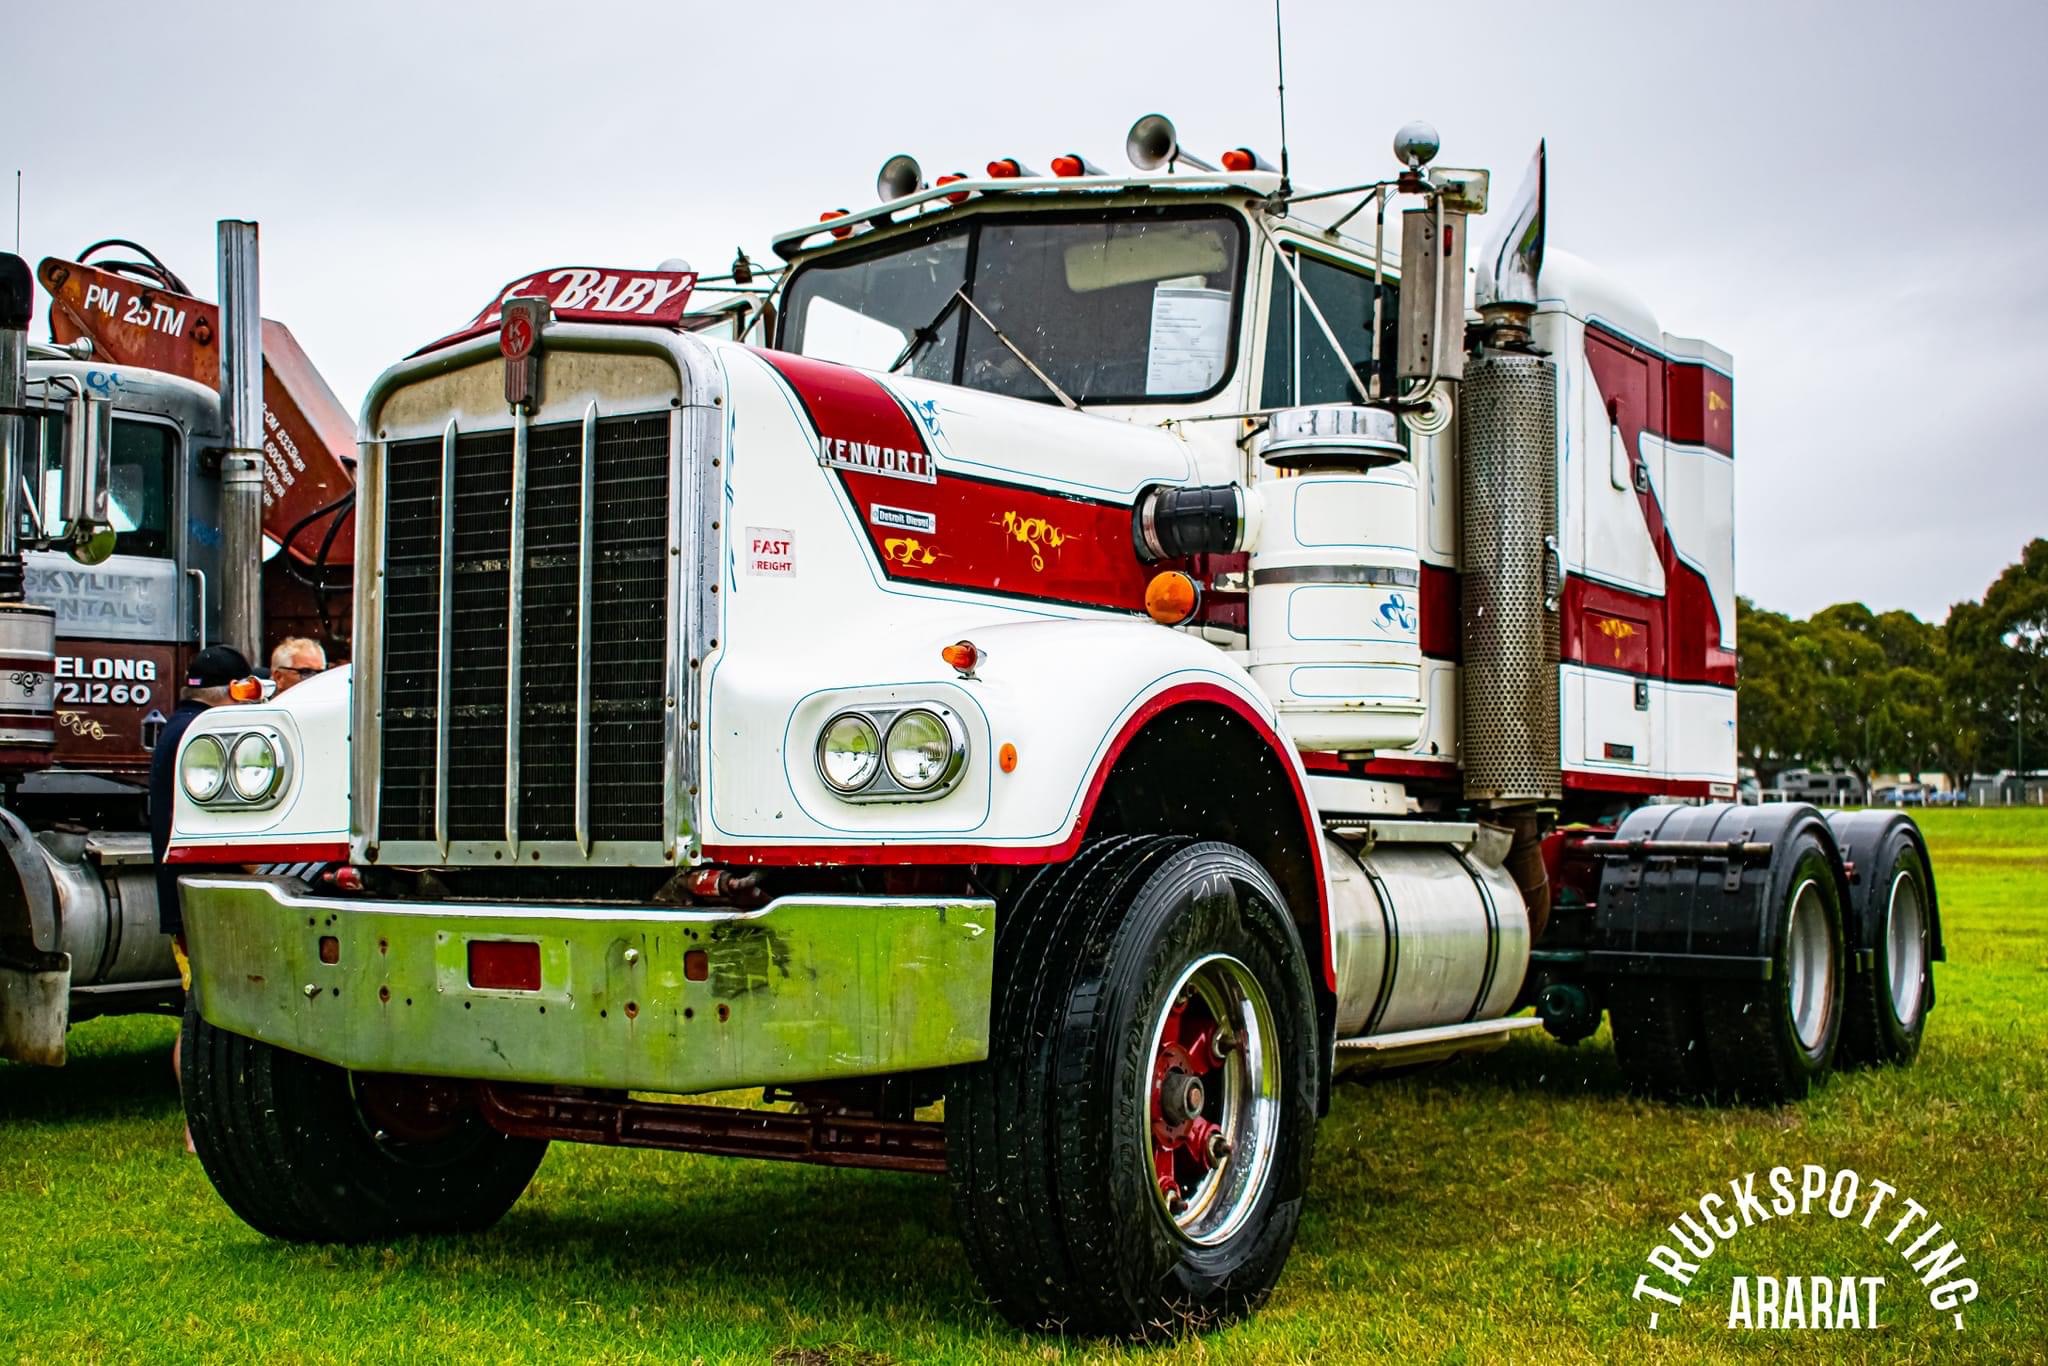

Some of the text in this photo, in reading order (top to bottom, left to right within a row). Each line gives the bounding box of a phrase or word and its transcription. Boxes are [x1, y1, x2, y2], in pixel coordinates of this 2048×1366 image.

[548, 268, 693, 315] BABY
[83, 284, 187, 338] PM 25TM
[820, 436, 937, 481] KENWORTH
[879, 510, 929, 528] Detroit Diesel
[753, 539, 790, 555] FAST
[752, 560, 792, 571] REIGHT
